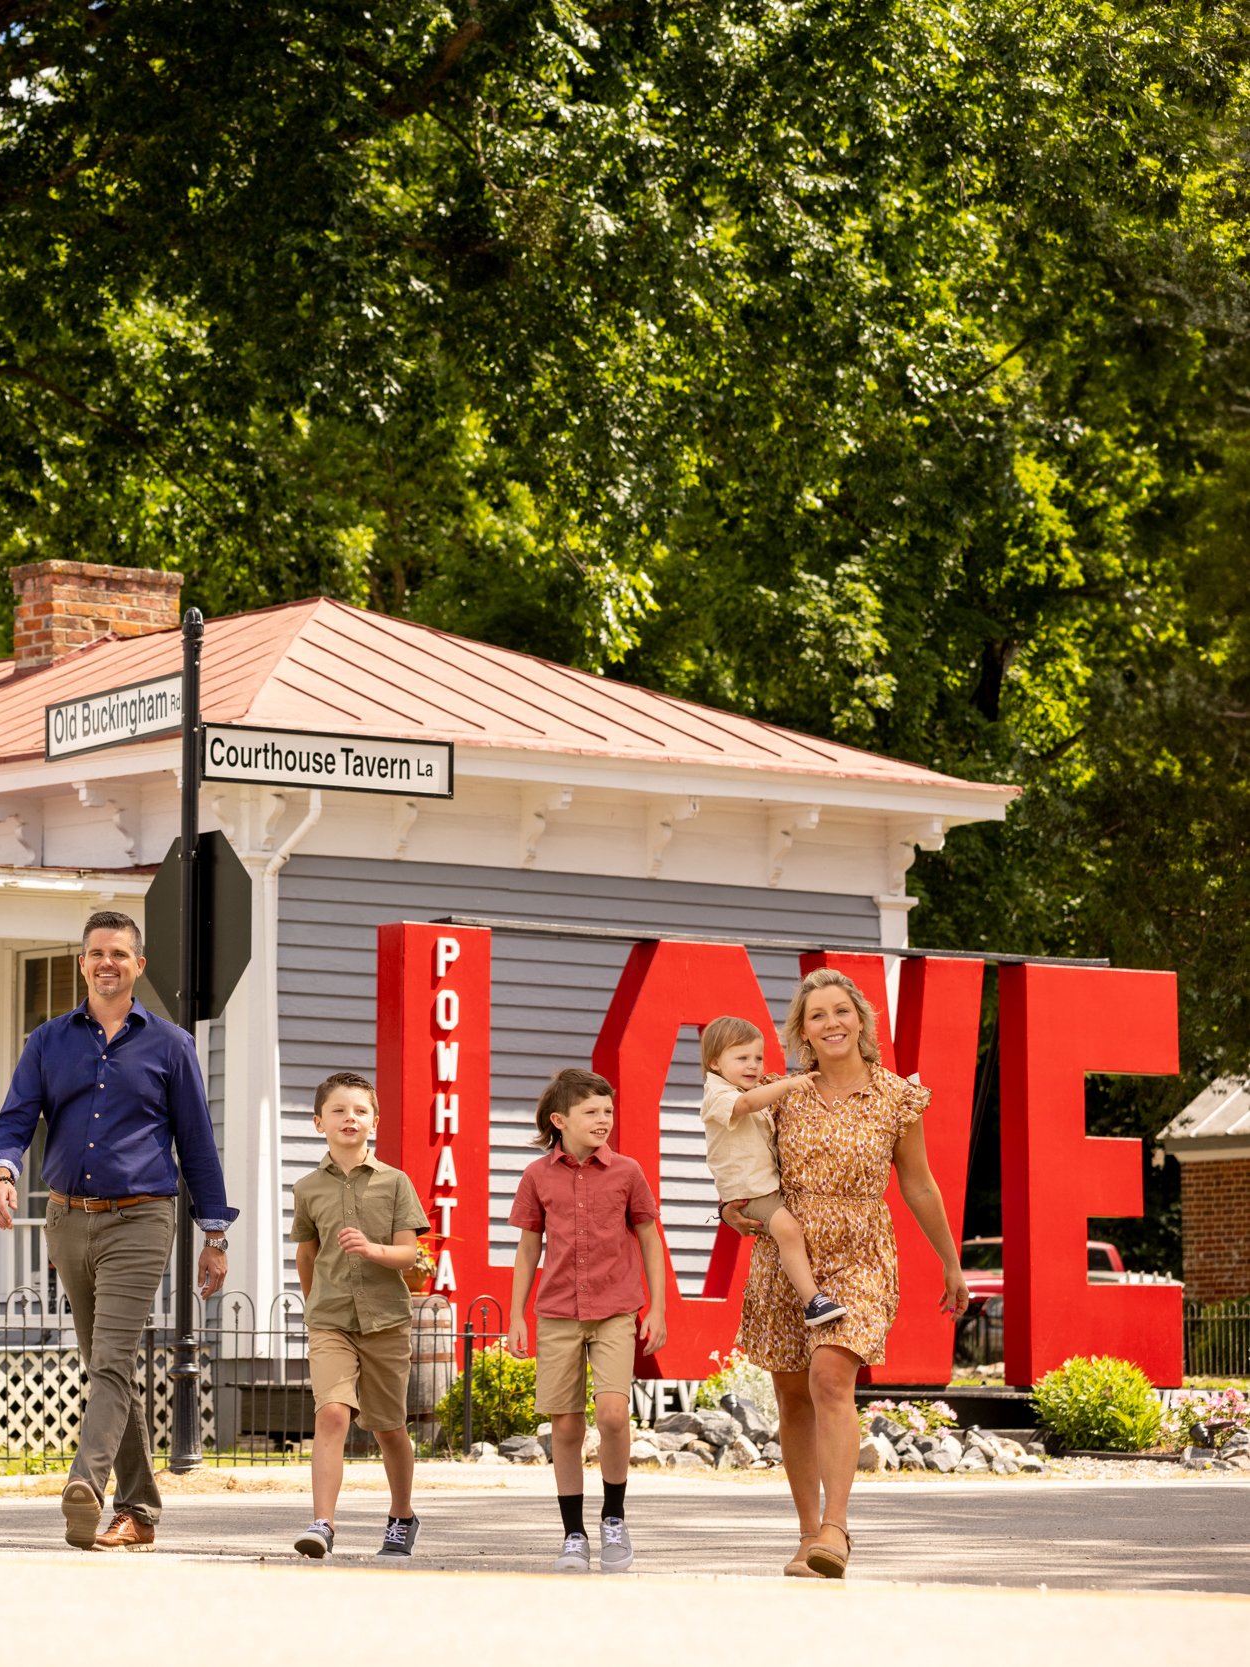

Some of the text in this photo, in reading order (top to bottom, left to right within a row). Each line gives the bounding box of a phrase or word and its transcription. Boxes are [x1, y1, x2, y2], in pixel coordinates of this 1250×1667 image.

[54, 689, 181, 744] Old Buckingham Rd
[210, 737, 433, 780] Courthouse Tavern La
